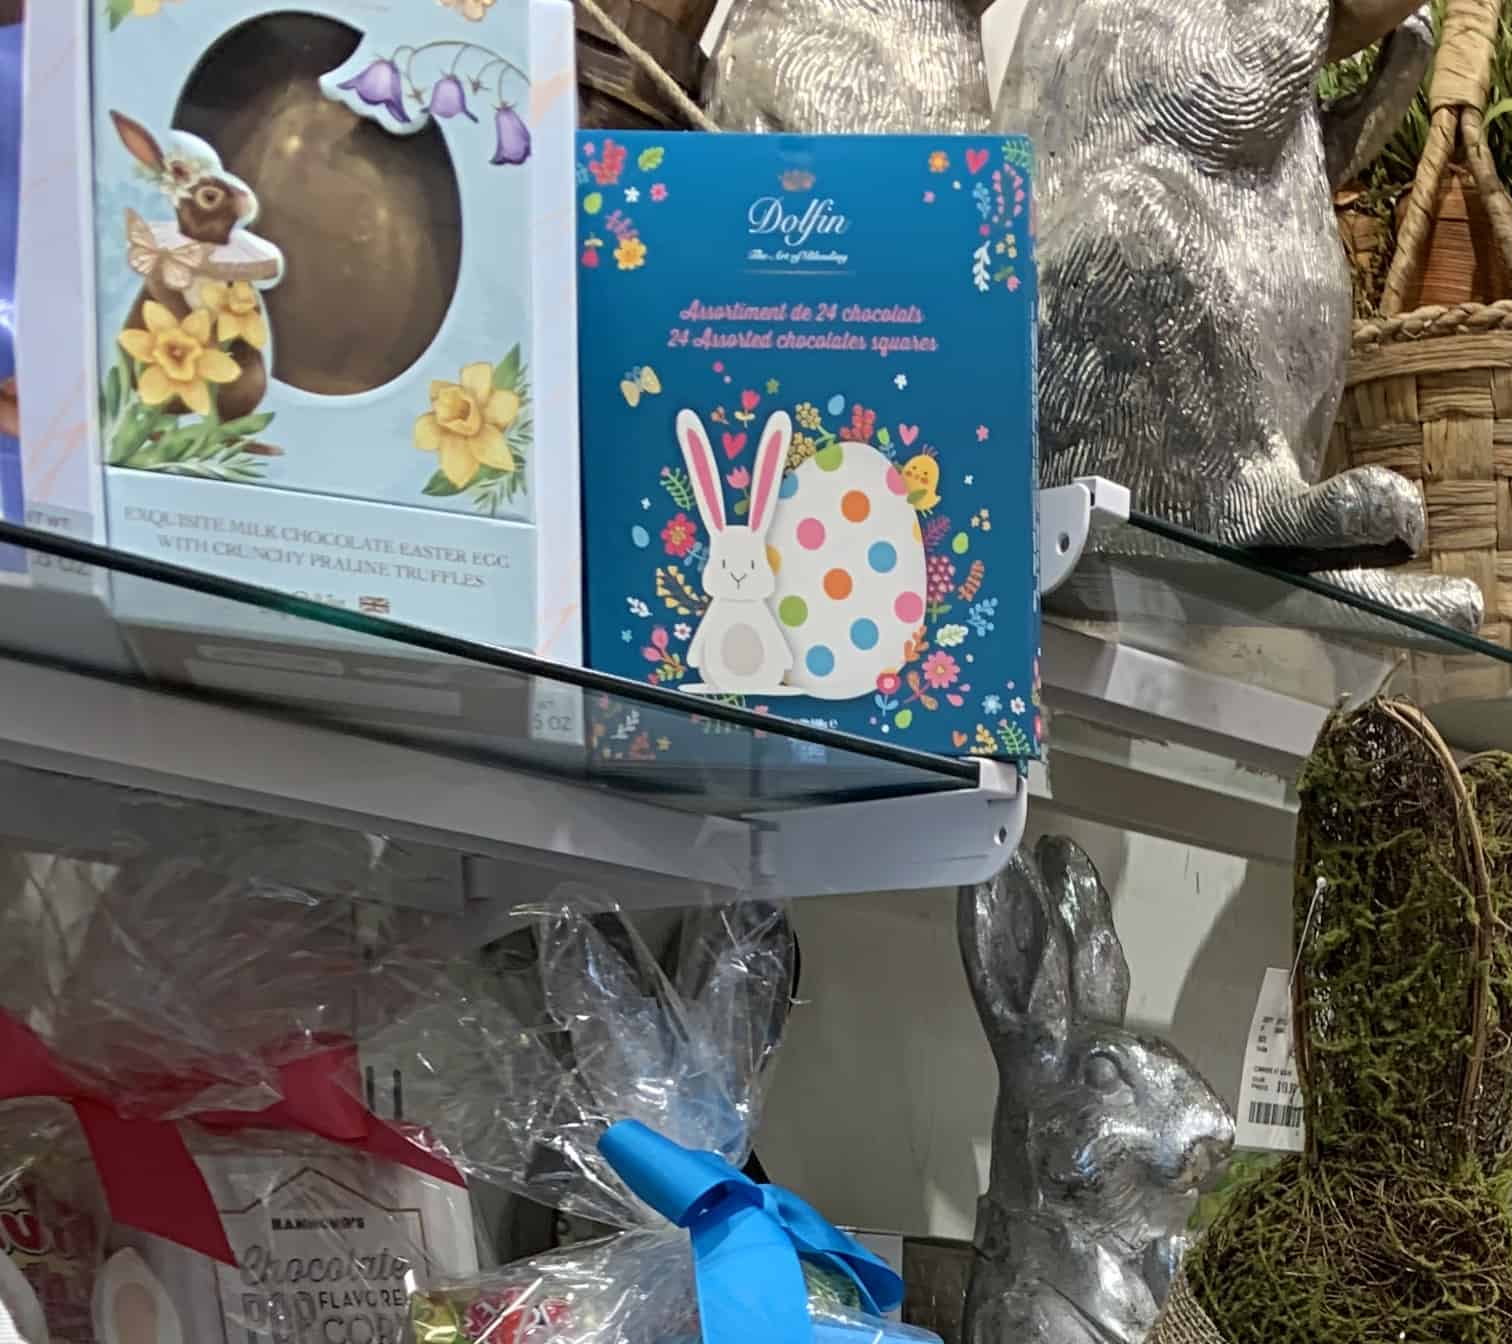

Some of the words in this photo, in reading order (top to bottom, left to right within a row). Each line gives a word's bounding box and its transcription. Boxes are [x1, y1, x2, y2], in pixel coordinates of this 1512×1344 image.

[748, 196, 849, 247] Dolfin
[680, 299, 786, 322] Assortiment
[790, 303, 814, 322] de
[815, 303, 837, 321] 24
[841, 304, 923, 324] chocolats
[667, 328, 689, 347] 24
[693, 326, 773, 350] Assorted
[775, 330, 867, 350] chocolates
[870, 333, 938, 357] squares
[124, 504, 221, 532] EXQUISITE
[228, 517, 279, 541] MILK
[280, 526, 396, 555] CHOCOLATE
[399, 541, 468, 566] EASTER
[471, 551, 512, 570] EGG
[157, 533, 208, 555] WITH
[211, 540, 306, 566] CRUNCHY
[308, 552, 390, 578] PRALINE
[393, 564, 487, 590] TRUFFLES
[240, 1245, 407, 1287] Chocolate
